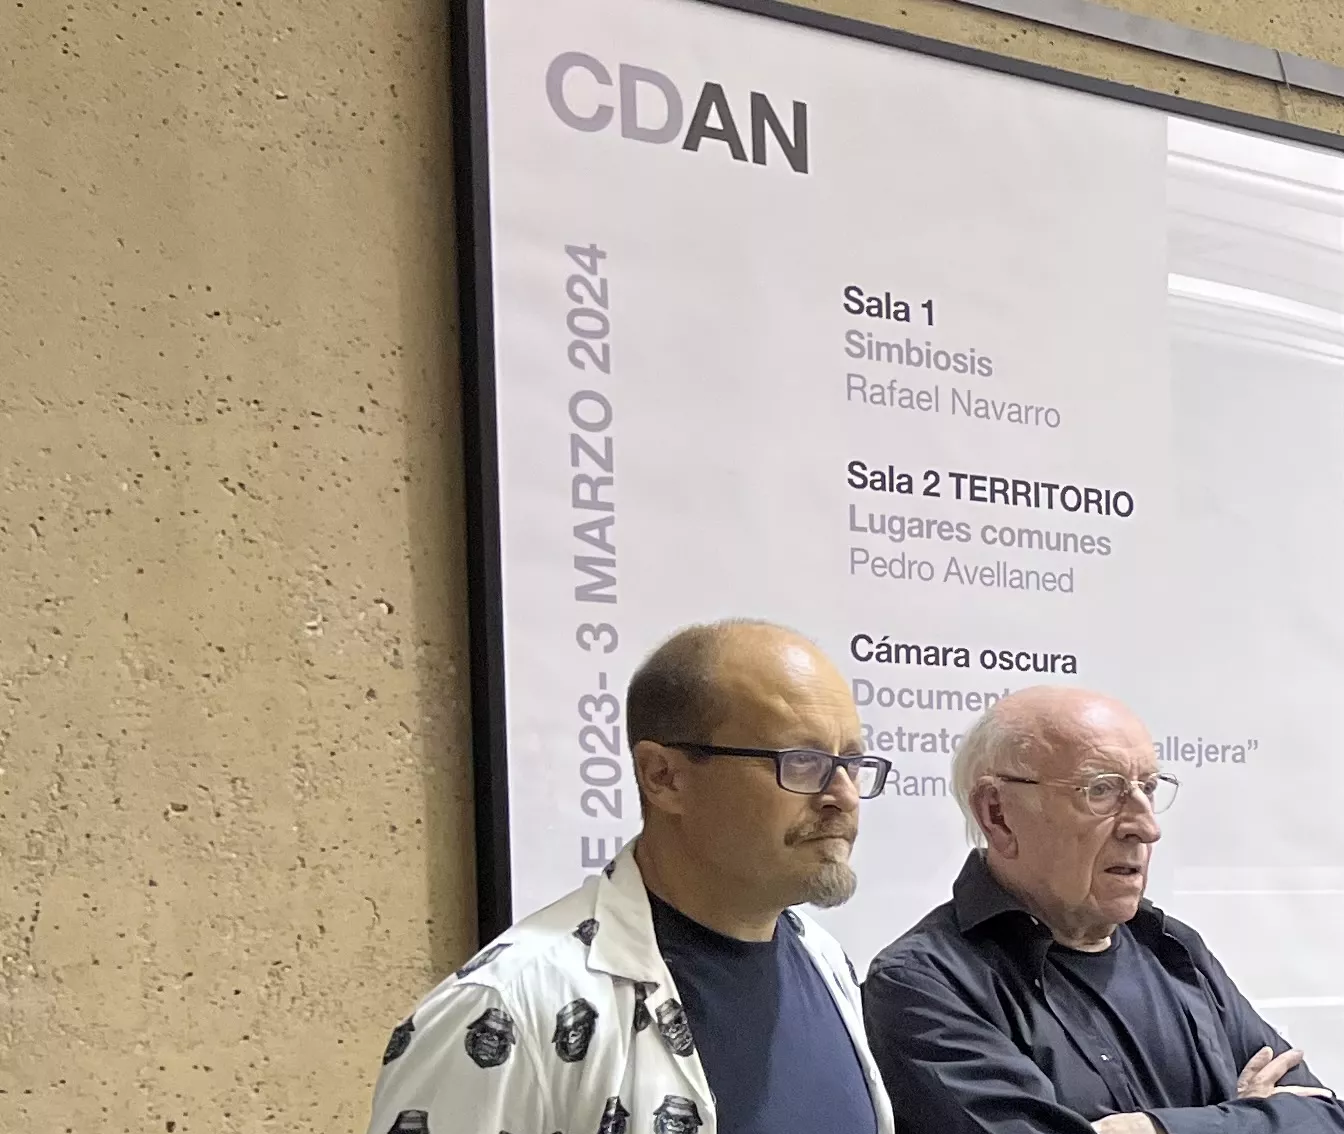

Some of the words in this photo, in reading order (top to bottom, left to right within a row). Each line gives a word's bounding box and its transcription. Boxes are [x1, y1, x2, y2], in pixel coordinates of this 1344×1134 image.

[545, 51, 808, 174] CDAN
[564, 243, 611, 375] 2024
[843, 285, 911, 323] Sala
[921, 299, 935, 327] 1
[844, 329, 994, 377] Simbiosis
[846, 372, 940, 413] Rafael
[951, 388, 1061, 428] Navarro
[568, 389, 617, 604] MARZO
[847, 460, 914, 495] Sala
[922, 470, 941, 498] 2
[948, 472, 1135, 518] TERRITORIO
[849, 503, 972, 544] Lugares
[980, 523, 1112, 556] comunes
[850, 546, 935, 582] Pedro
[943, 556, 1075, 593] Avellaned
[575, 622, 619, 654] 3
[850, 633, 970, 669] Cámara
[979, 645, 1078, 675] oscura
[577, 671, 623, 820] 2023-
